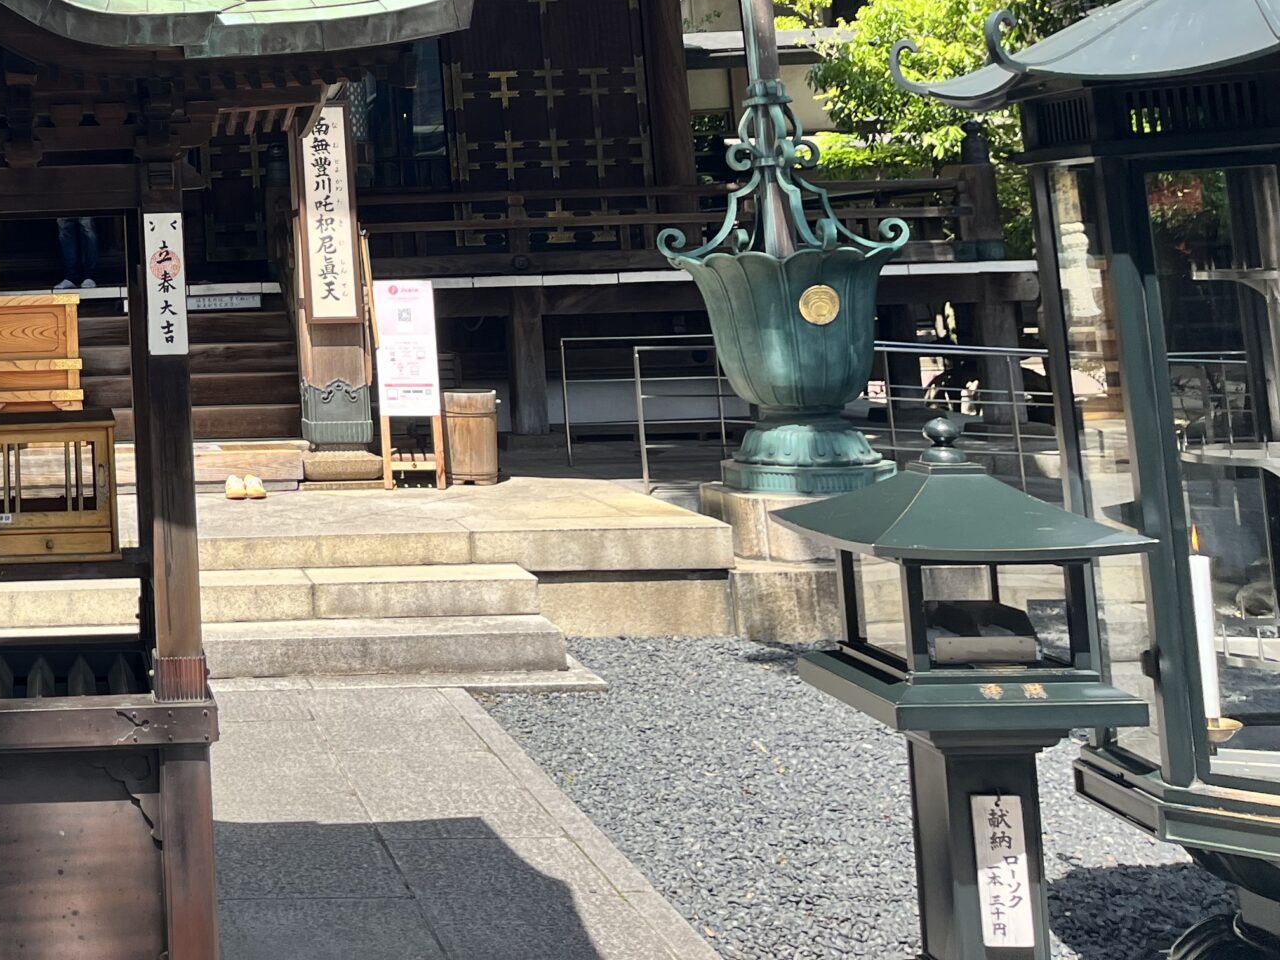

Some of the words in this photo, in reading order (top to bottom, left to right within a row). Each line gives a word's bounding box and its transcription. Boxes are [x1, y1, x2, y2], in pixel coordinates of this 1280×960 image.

[156, 240, 178, 344] 立春大吉
[987, 809, 1013, 850] 献納
[1002, 855, 1023, 909] ローソク
